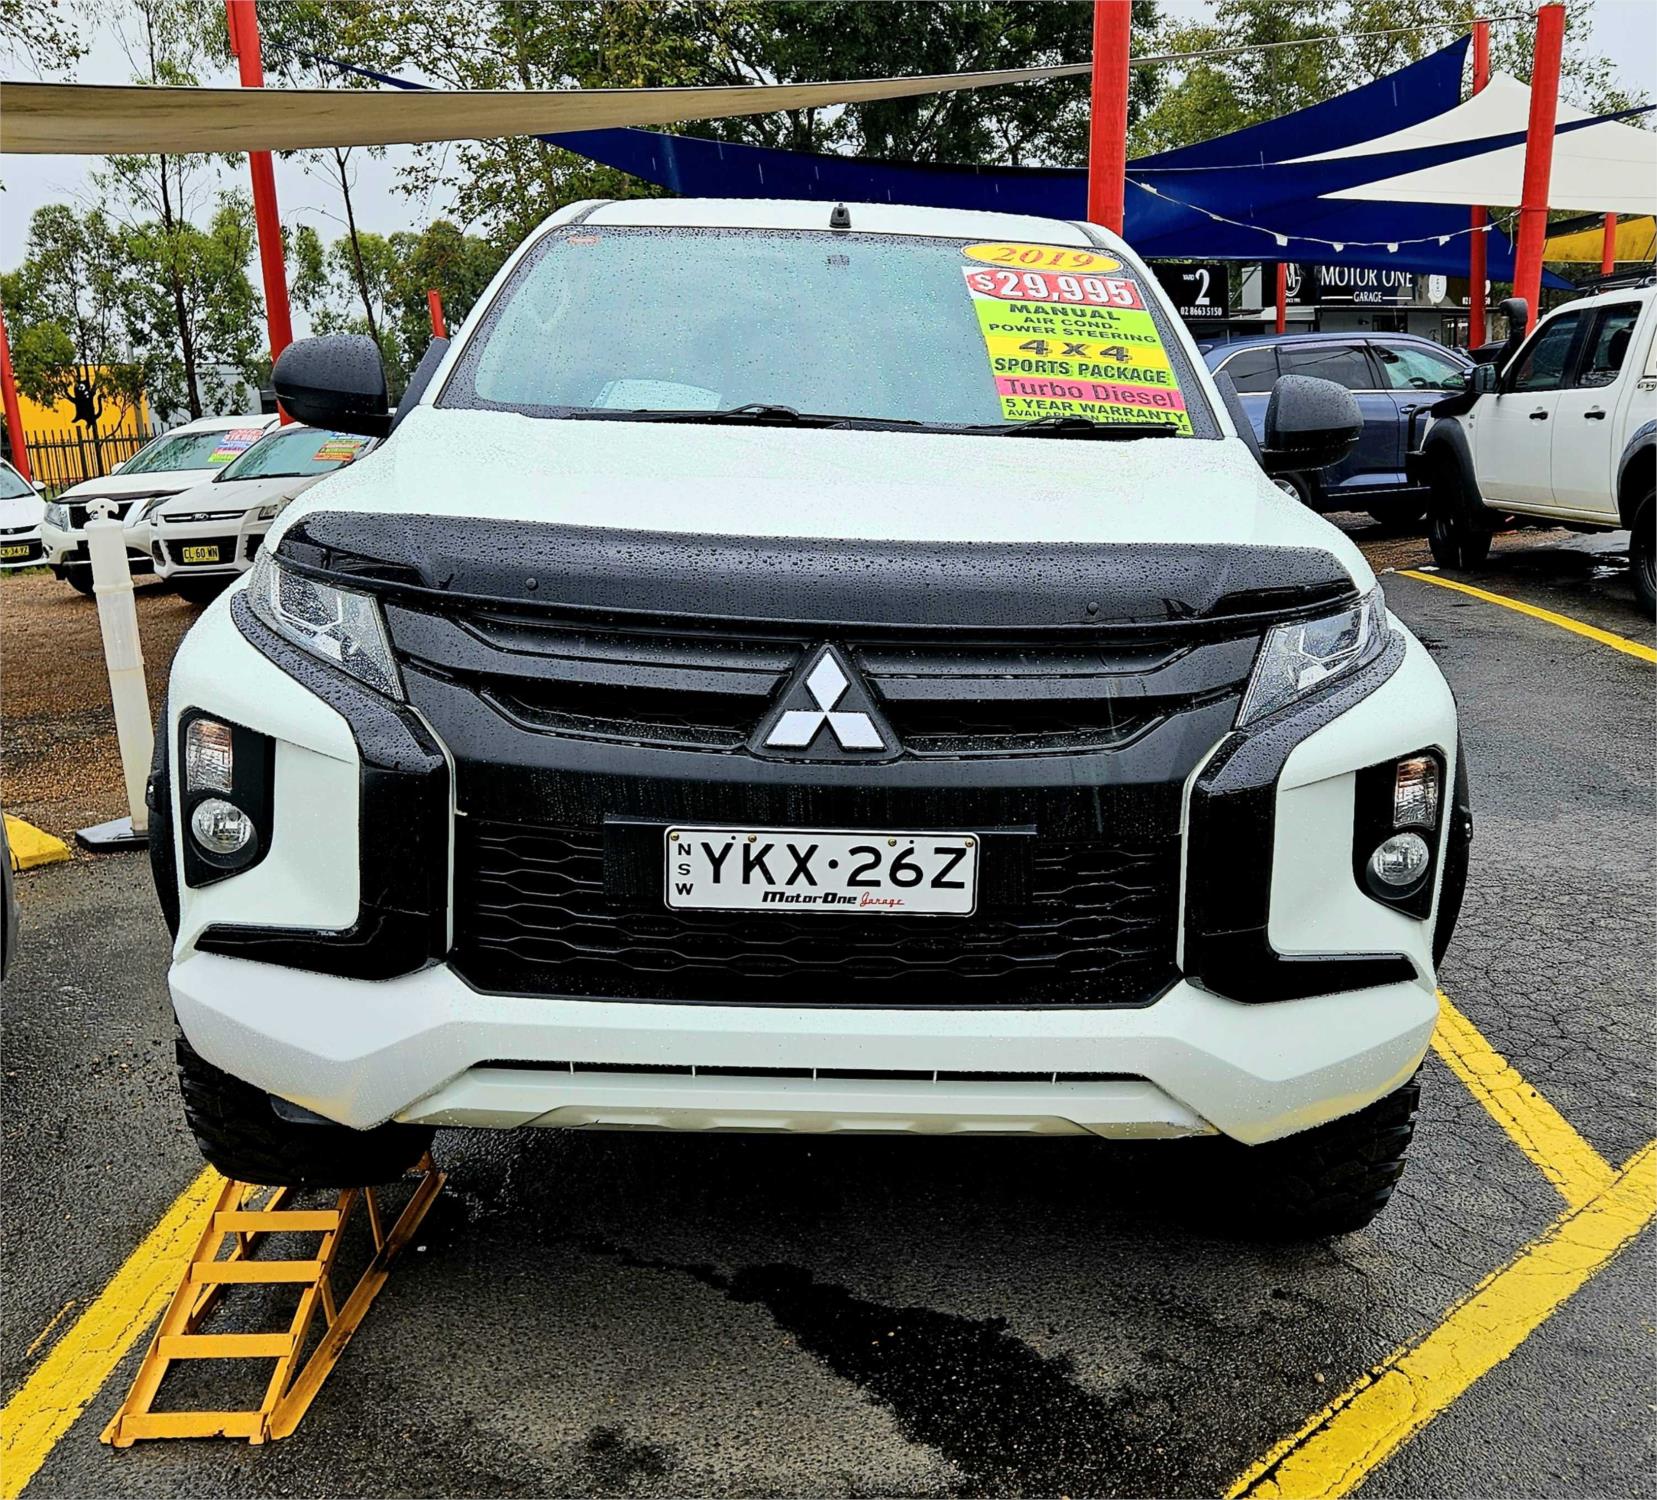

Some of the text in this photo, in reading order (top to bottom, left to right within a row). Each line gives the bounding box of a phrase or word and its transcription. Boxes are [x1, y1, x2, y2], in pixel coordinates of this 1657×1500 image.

[992, 246, 1095, 268] 2019
[974, 270, 1135, 306] $29,995
[1194, 268, 1210, 306] 2
[1353, 291, 1382, 303] GARAGE
[1009, 303, 1121, 321] MANUAL
[1180, 306, 1223, 316] 02 8663 5150
[988, 322, 1157, 343] POWER STEERING
[1024, 316, 1119, 331] AIR COND.
[1019, 339, 1051, 357] 4
[1099, 345, 1131, 363] 4
[994, 357, 1168, 385] SPORTS PACKAGE
[1003, 378, 1176, 408] Turbo Diesel
[1005, 398, 1185, 423] 5 YEAR WARRANTY
[859, 891, 905, 907] Garage
